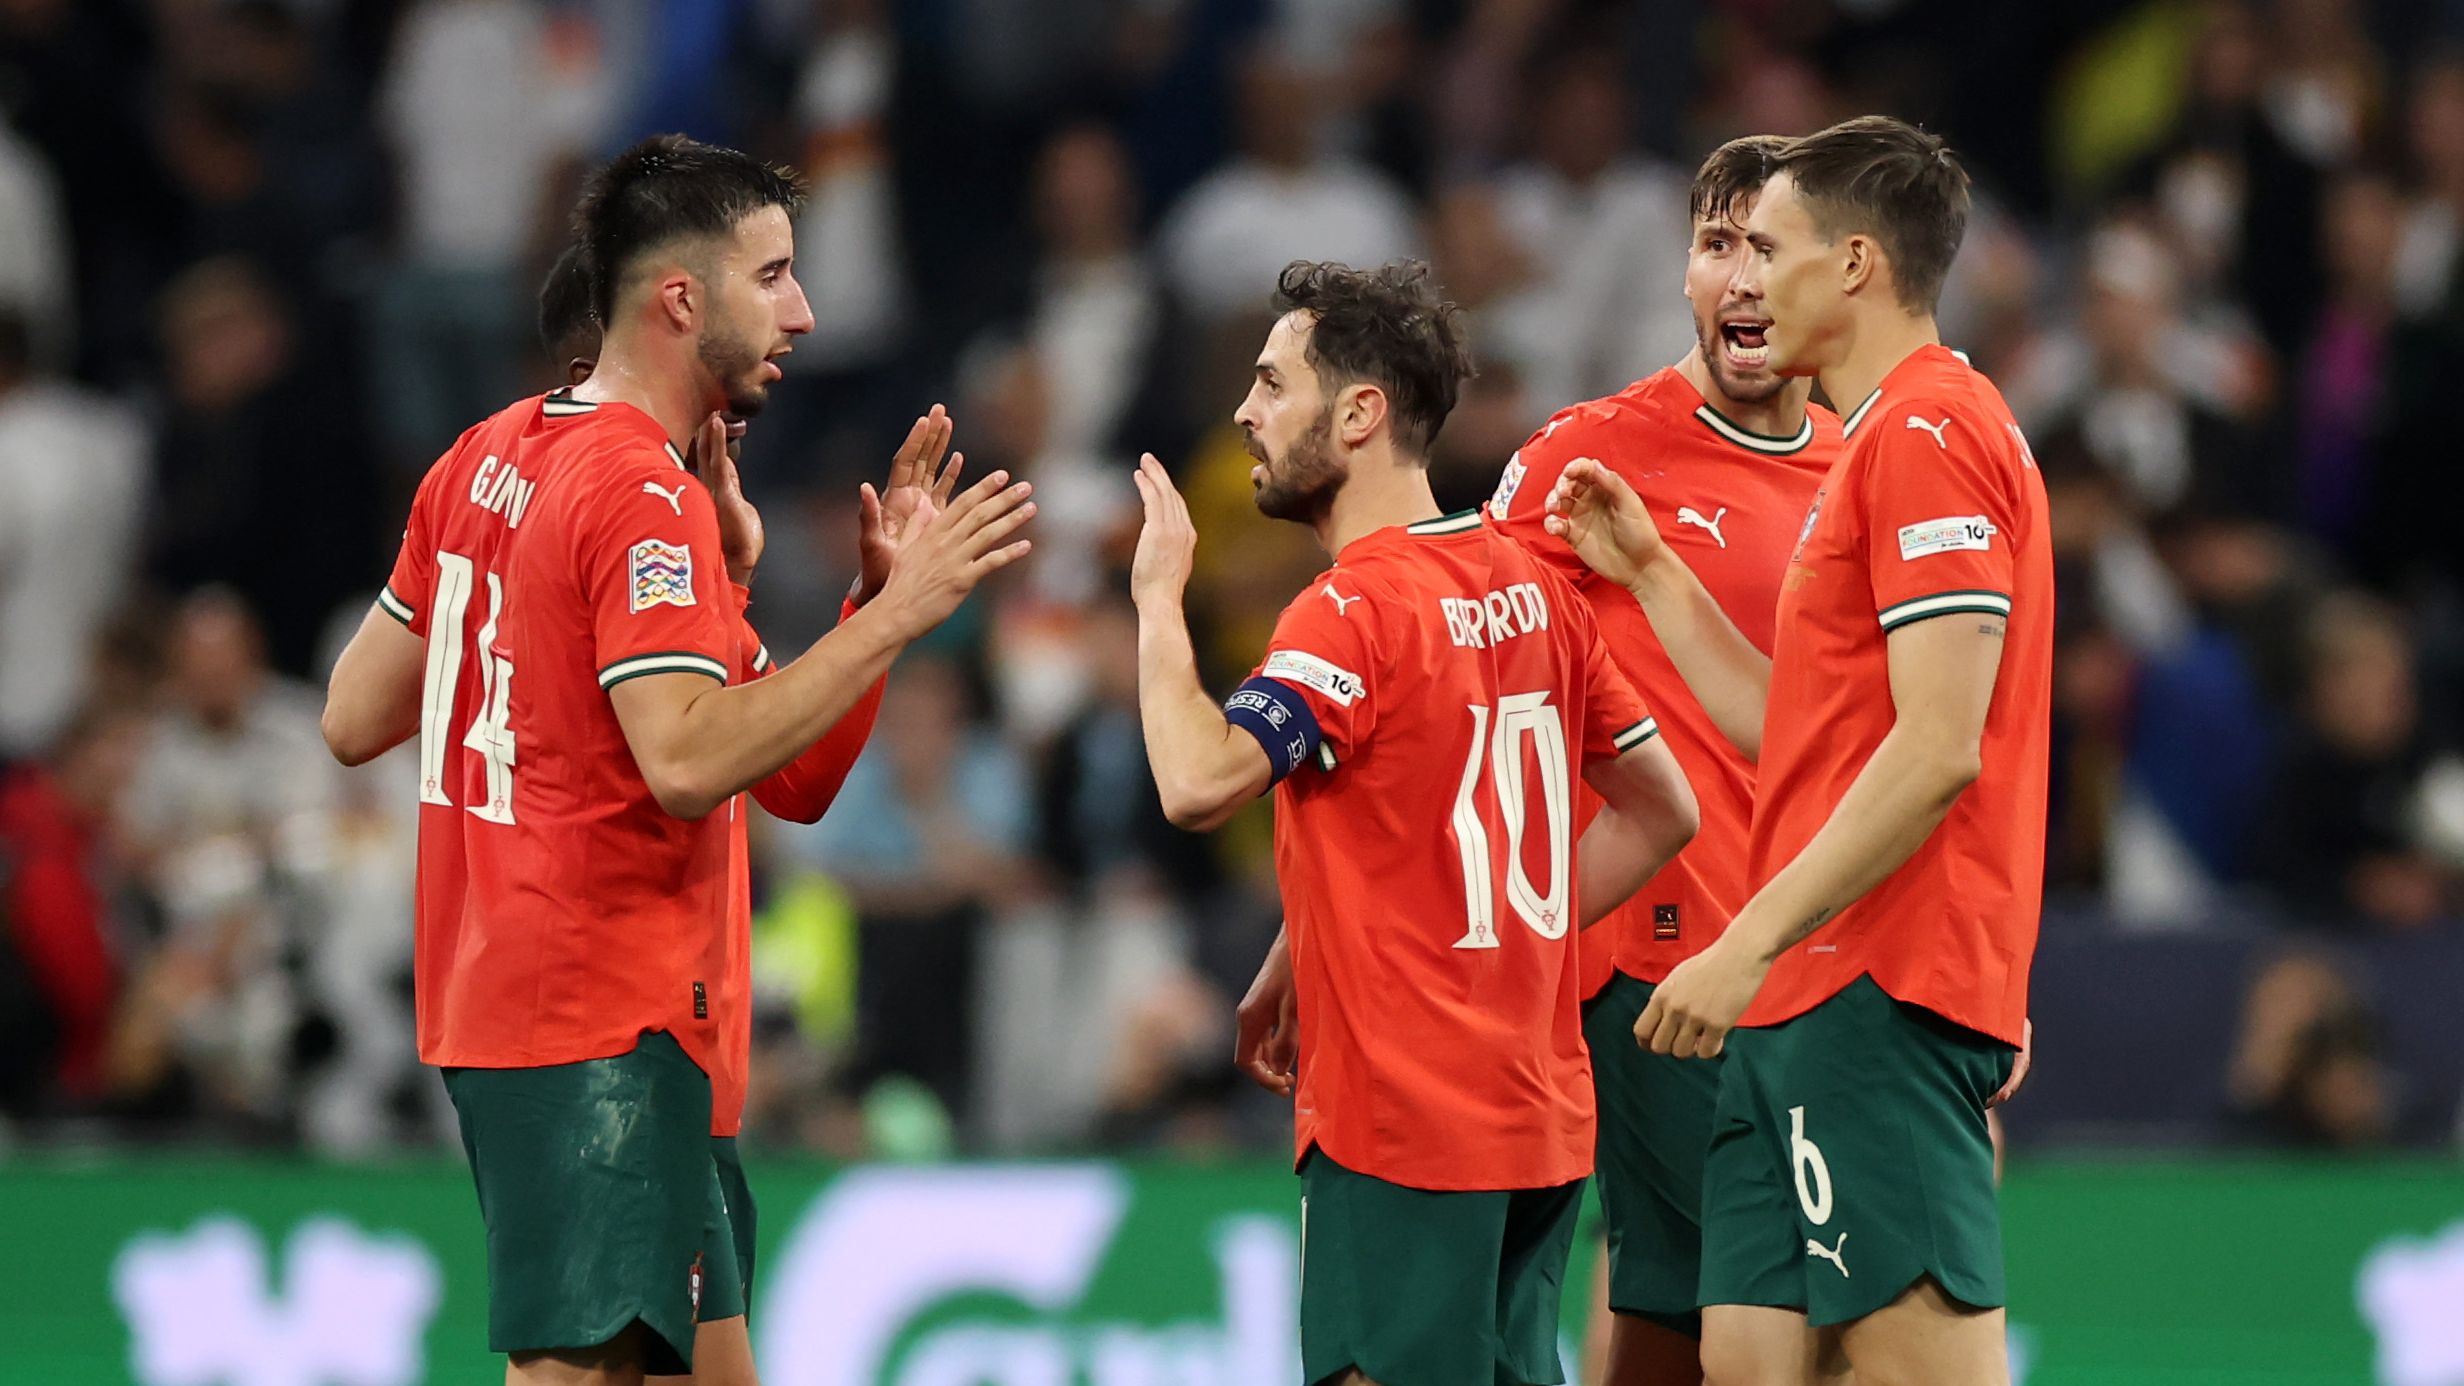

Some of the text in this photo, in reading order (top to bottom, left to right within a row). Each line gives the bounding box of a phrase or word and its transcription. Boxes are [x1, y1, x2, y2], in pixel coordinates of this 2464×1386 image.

[1965, 524, 1985, 540] 10
[420, 549, 517, 826] 14
[1331, 674, 1352, 695] 10
[1451, 690, 1570, 949] 10
[1788, 1105, 1833, 1226] 6
